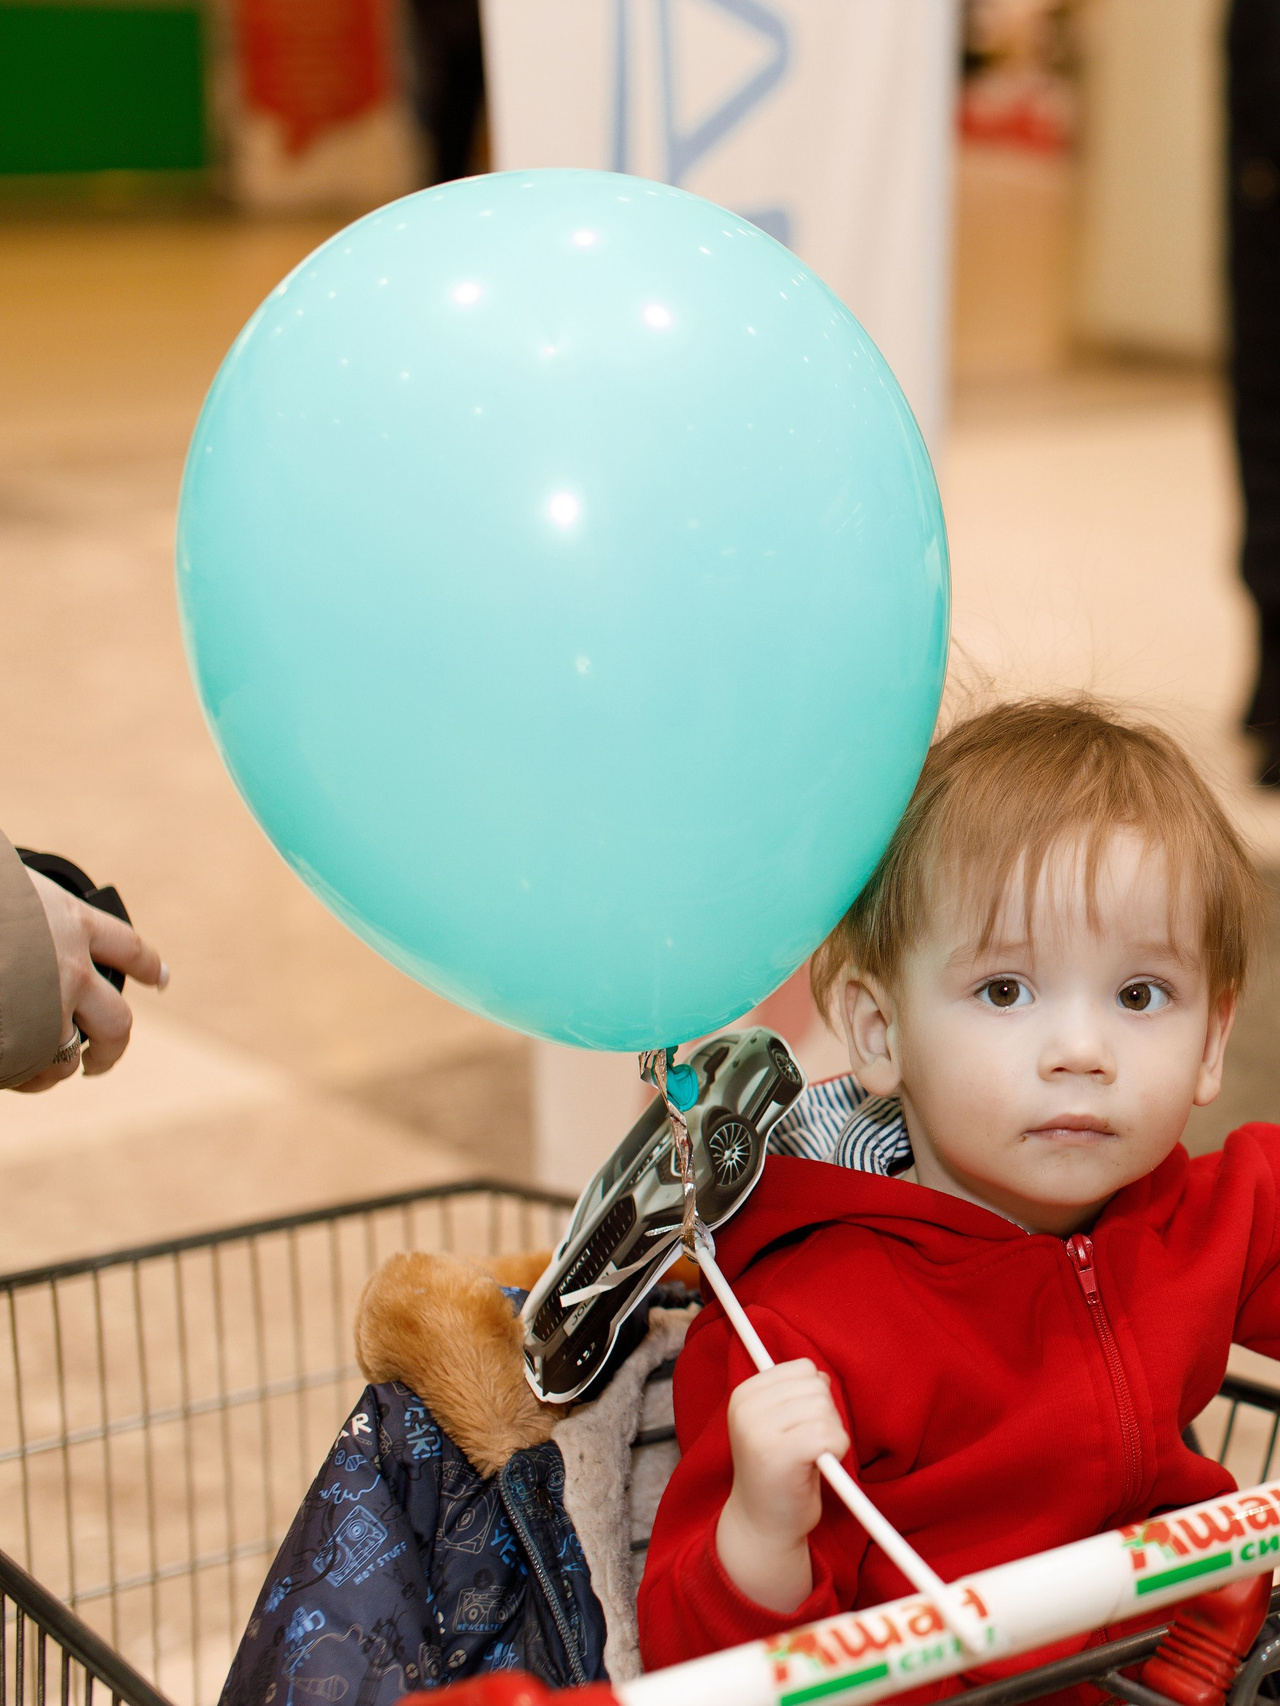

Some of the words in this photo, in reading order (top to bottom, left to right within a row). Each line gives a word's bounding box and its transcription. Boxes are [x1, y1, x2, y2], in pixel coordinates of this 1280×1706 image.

[404, 1396, 443, 1459] EAR!
[353, 1563, 376, 1586] HOT
[376, 1541, 407, 1568] STUFF
